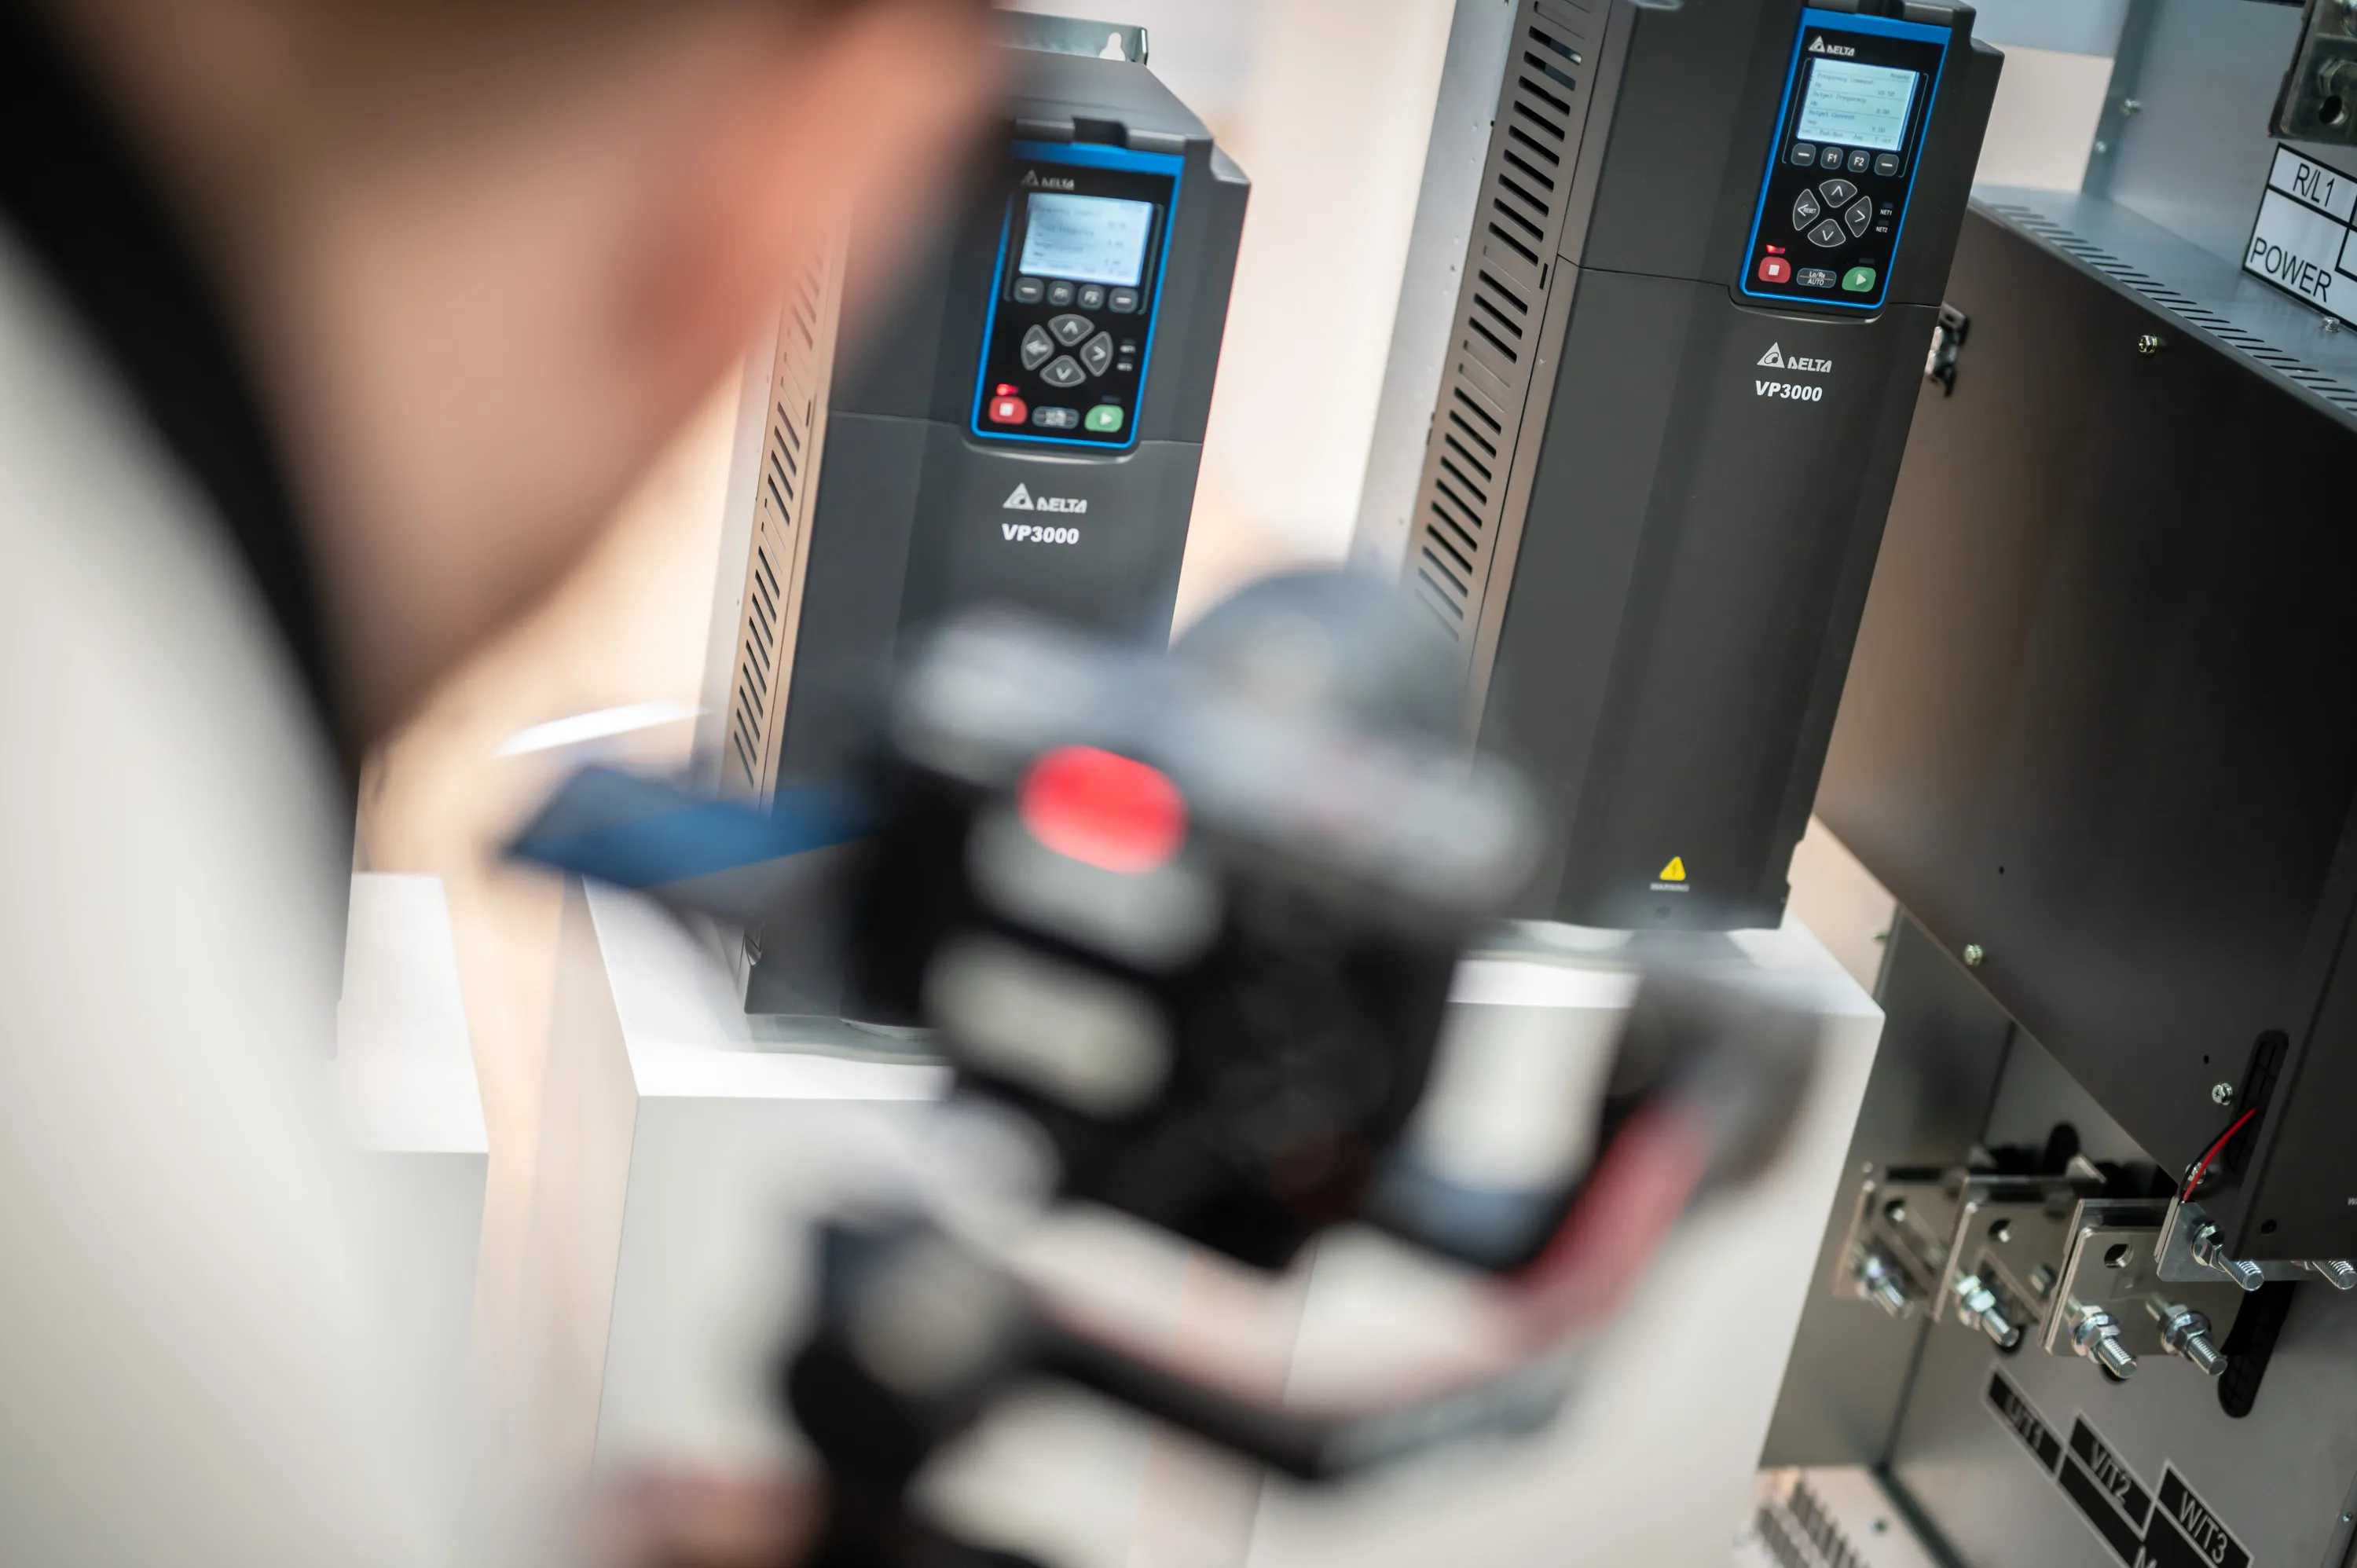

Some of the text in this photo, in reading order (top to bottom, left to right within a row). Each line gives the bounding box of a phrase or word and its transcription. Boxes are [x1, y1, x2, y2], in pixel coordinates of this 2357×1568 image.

[1827, 44, 1855, 56] DELTA
[1816, 73, 1847, 82] Frequency
[1827, 153, 1838, 163] F1
[1854, 156, 1864, 167] F2
[2293, 162, 2335, 207] R/L1
[1809, 270, 1826, 279] Lo/Re
[2249, 236, 2332, 302] POWER
[1787, 356, 1832, 373] DELTA
[1755, 380, 1823, 401] VP3000
[1036, 496, 1088, 514] DELTA
[1002, 523, 1080, 544] VP3000
[2090, 1438, 2132, 1506] V/T2
[2178, 1491, 2228, 1565] W/T3
